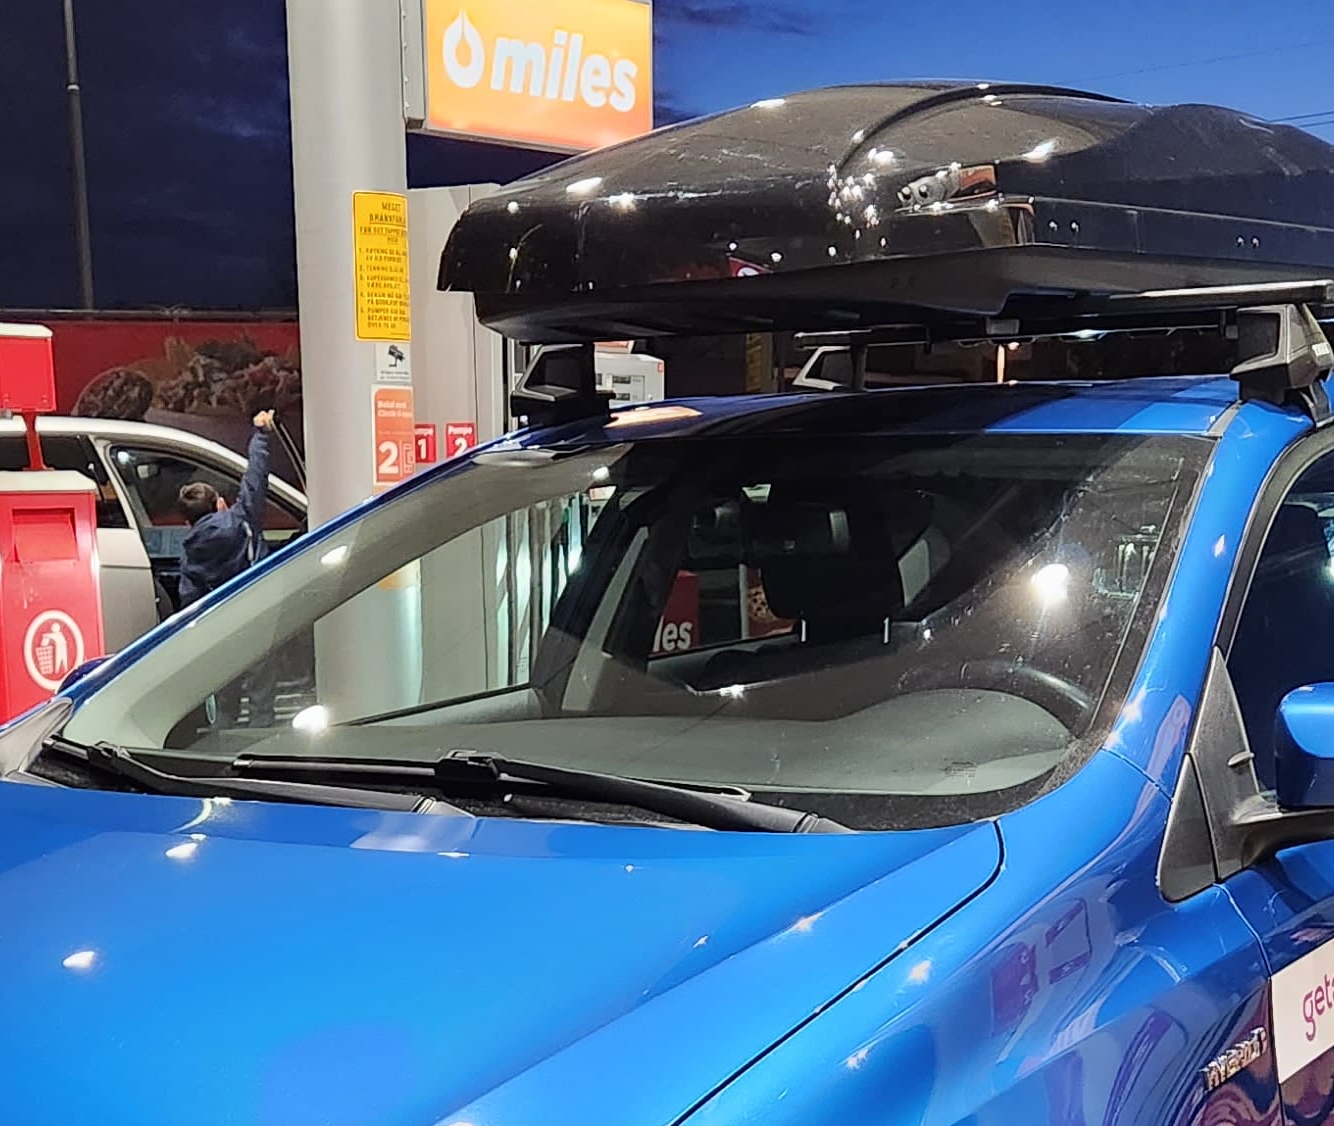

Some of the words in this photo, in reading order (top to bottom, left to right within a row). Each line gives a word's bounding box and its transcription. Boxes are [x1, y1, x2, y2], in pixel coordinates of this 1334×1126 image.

[491, 29, 638, 113] miles
[378, 441, 399, 474] 2
[417, 438, 427, 460] 1
[454, 437, 468, 458] 2
